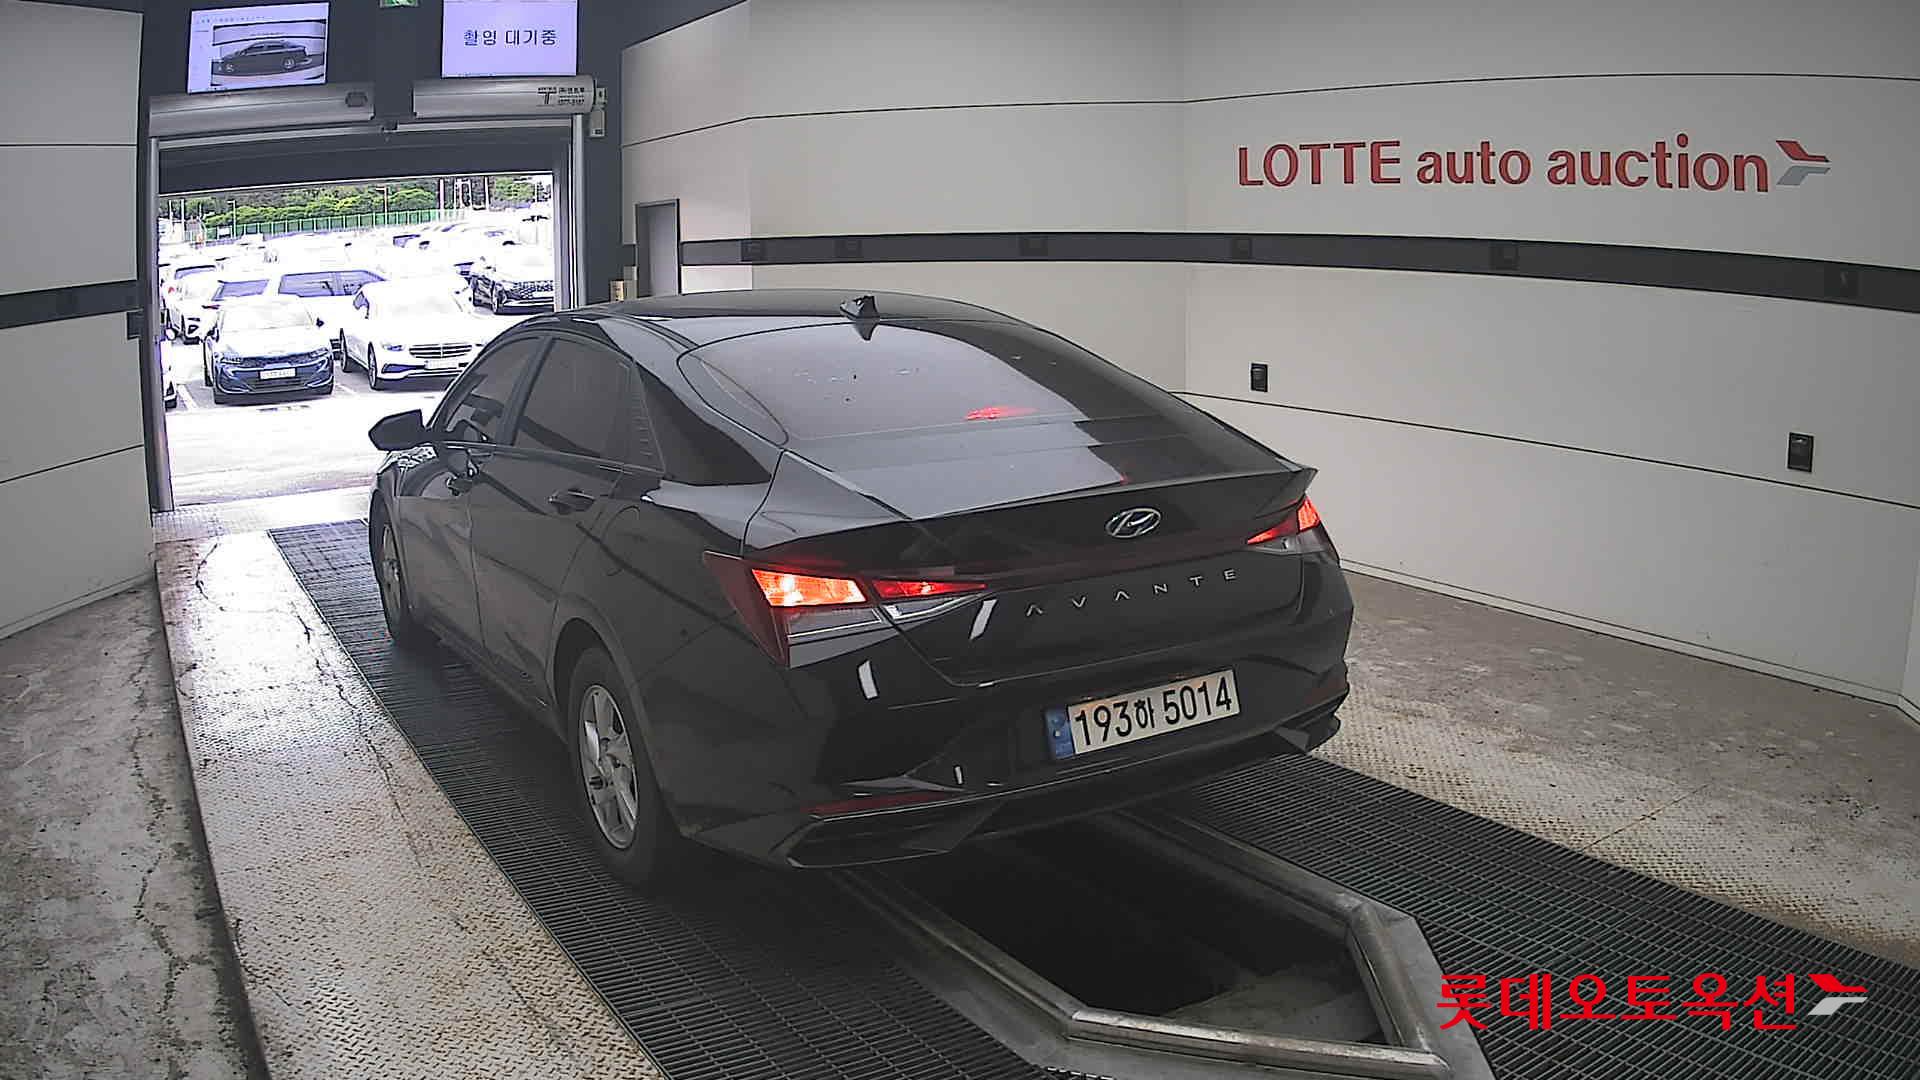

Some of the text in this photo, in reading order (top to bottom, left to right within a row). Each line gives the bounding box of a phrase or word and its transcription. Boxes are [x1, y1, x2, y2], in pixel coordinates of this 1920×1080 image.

[504, 29, 557, 46] 대기중
[1238, 132, 1770, 193] LOTTE auto auction
[1025, 568, 1239, 617] AVANTE
[1074, 676, 1233, 747] 193하 5014
